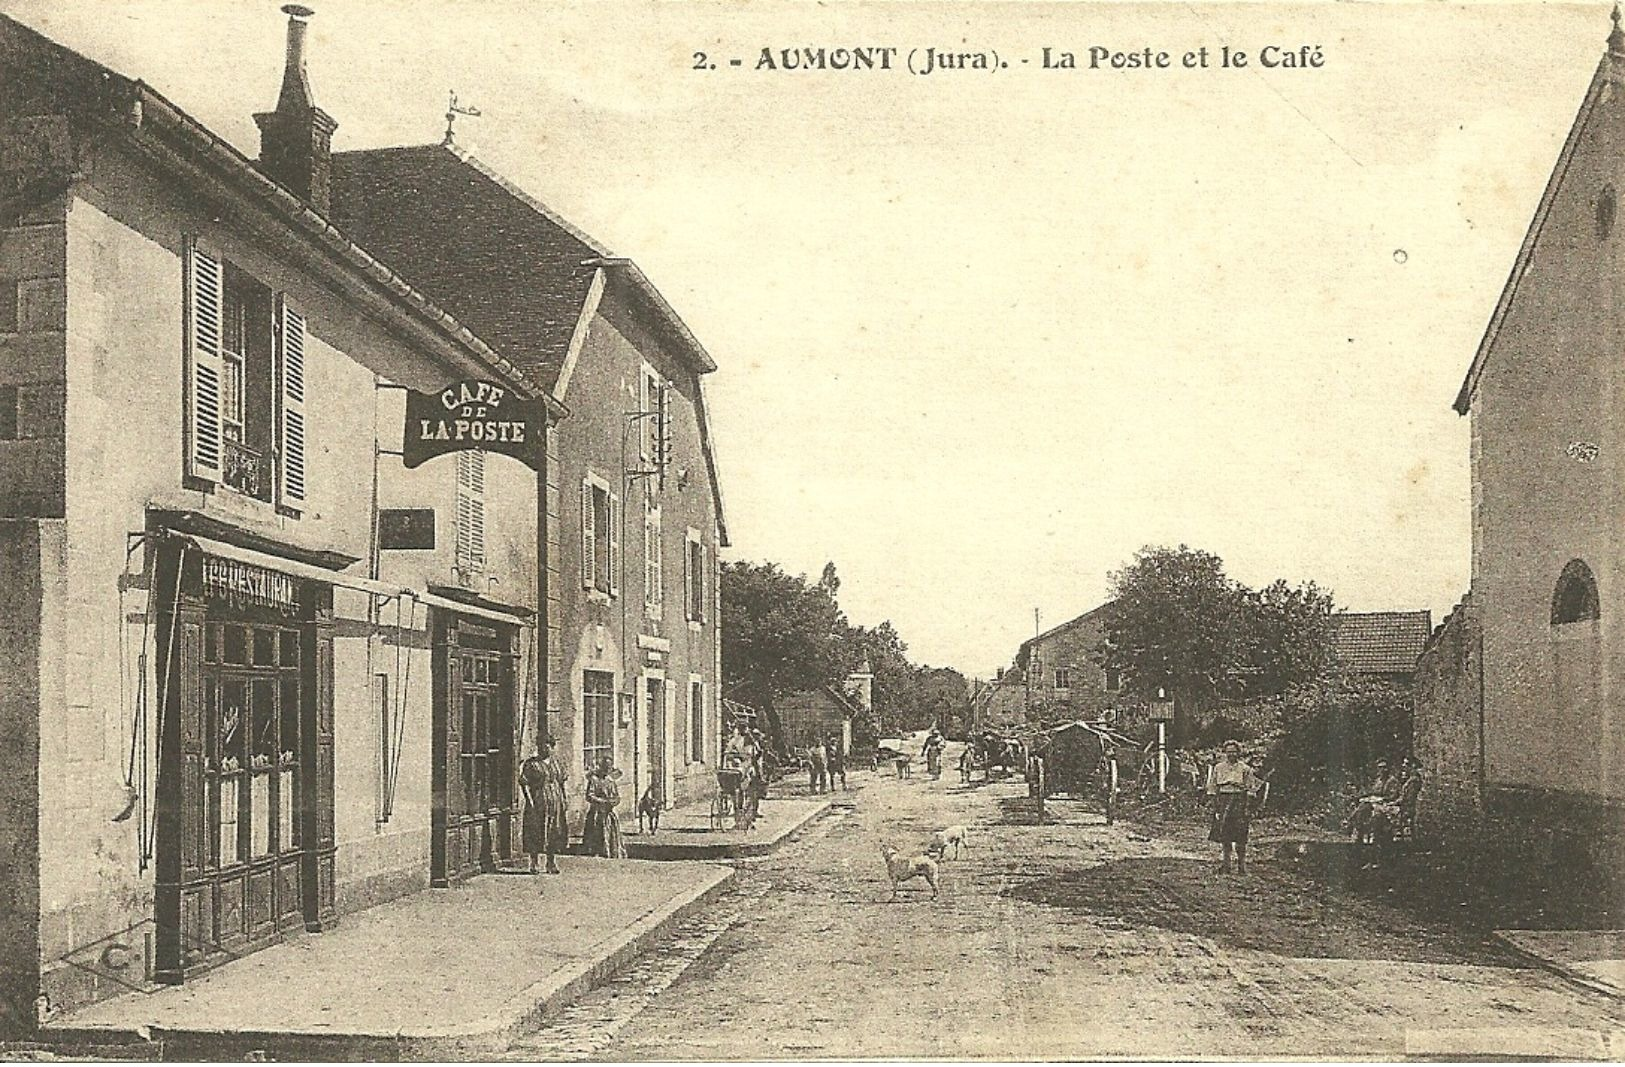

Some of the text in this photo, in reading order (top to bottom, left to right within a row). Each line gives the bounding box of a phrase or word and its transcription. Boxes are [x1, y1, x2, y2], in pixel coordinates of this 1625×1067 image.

[441, 381, 504, 410] CAFE
[461, 407, 487, 417] DE
[420, 420, 525, 443] LA POSTE
